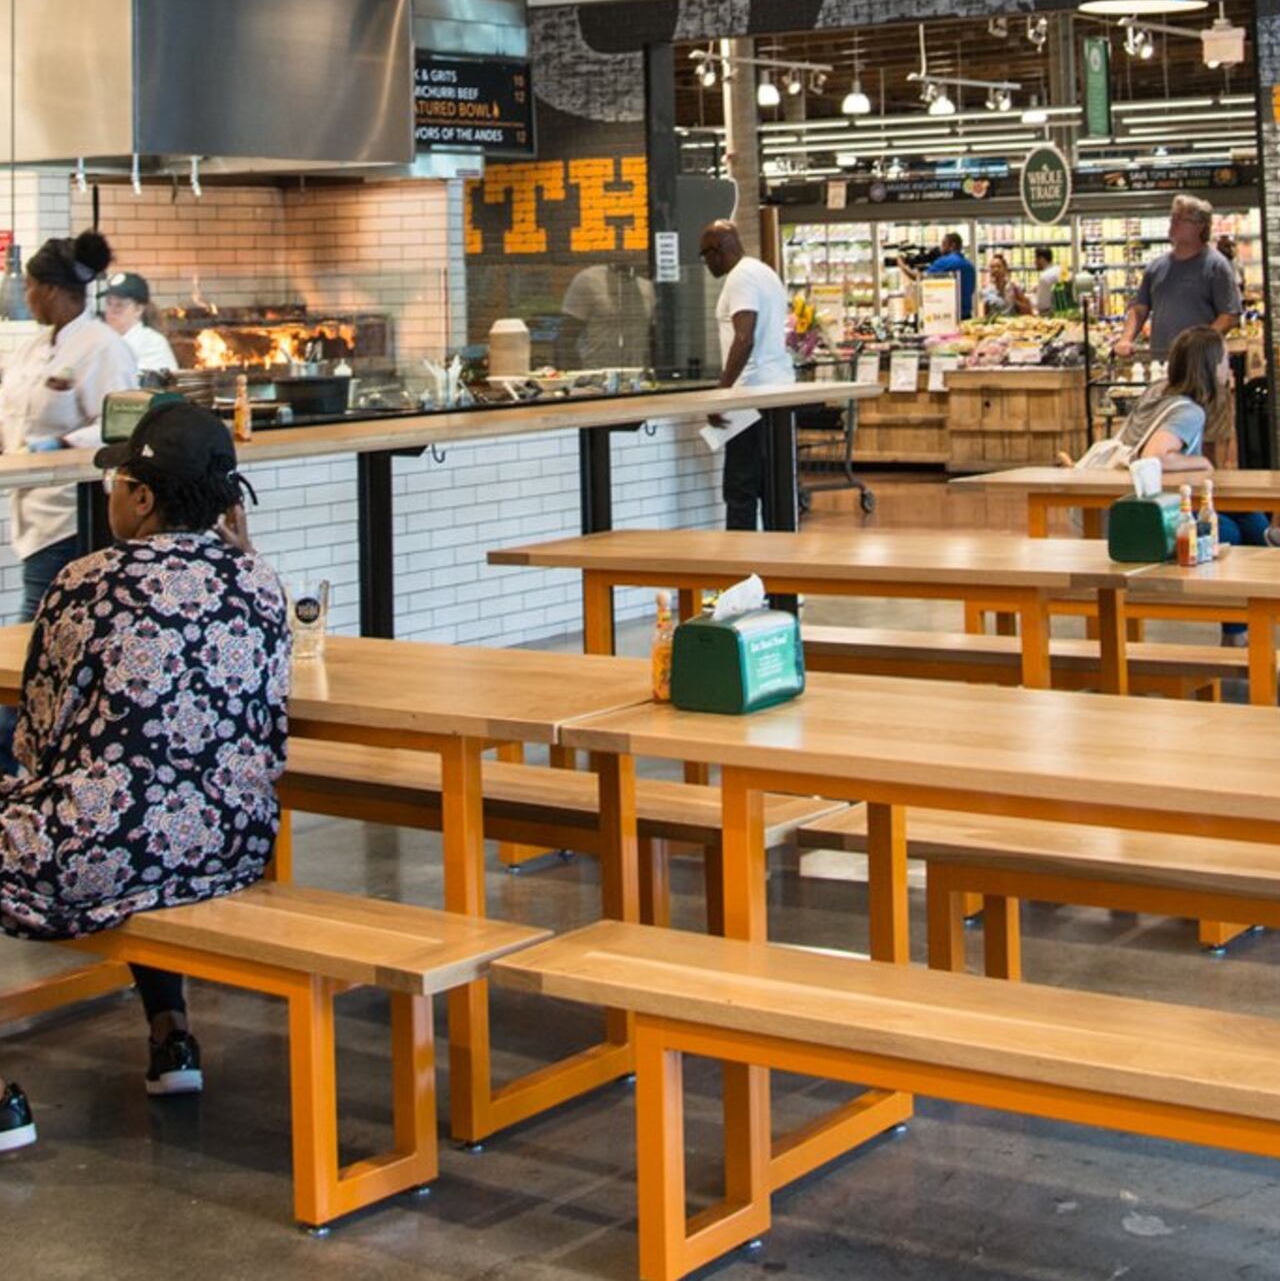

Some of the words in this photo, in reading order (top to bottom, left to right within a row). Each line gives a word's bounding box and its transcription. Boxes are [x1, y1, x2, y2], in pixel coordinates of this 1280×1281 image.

[430, 70, 457, 83] GRITS
[458, 87, 479, 99] BEEF
[458, 102, 492, 119] BOWL
[441, 128, 454, 140] OF
[456, 128, 473, 141] THE
[474, 129, 504, 142] ANDES
[1027, 170, 1063, 184] WHOLE
[1030, 185, 1062, 199] TRADE
